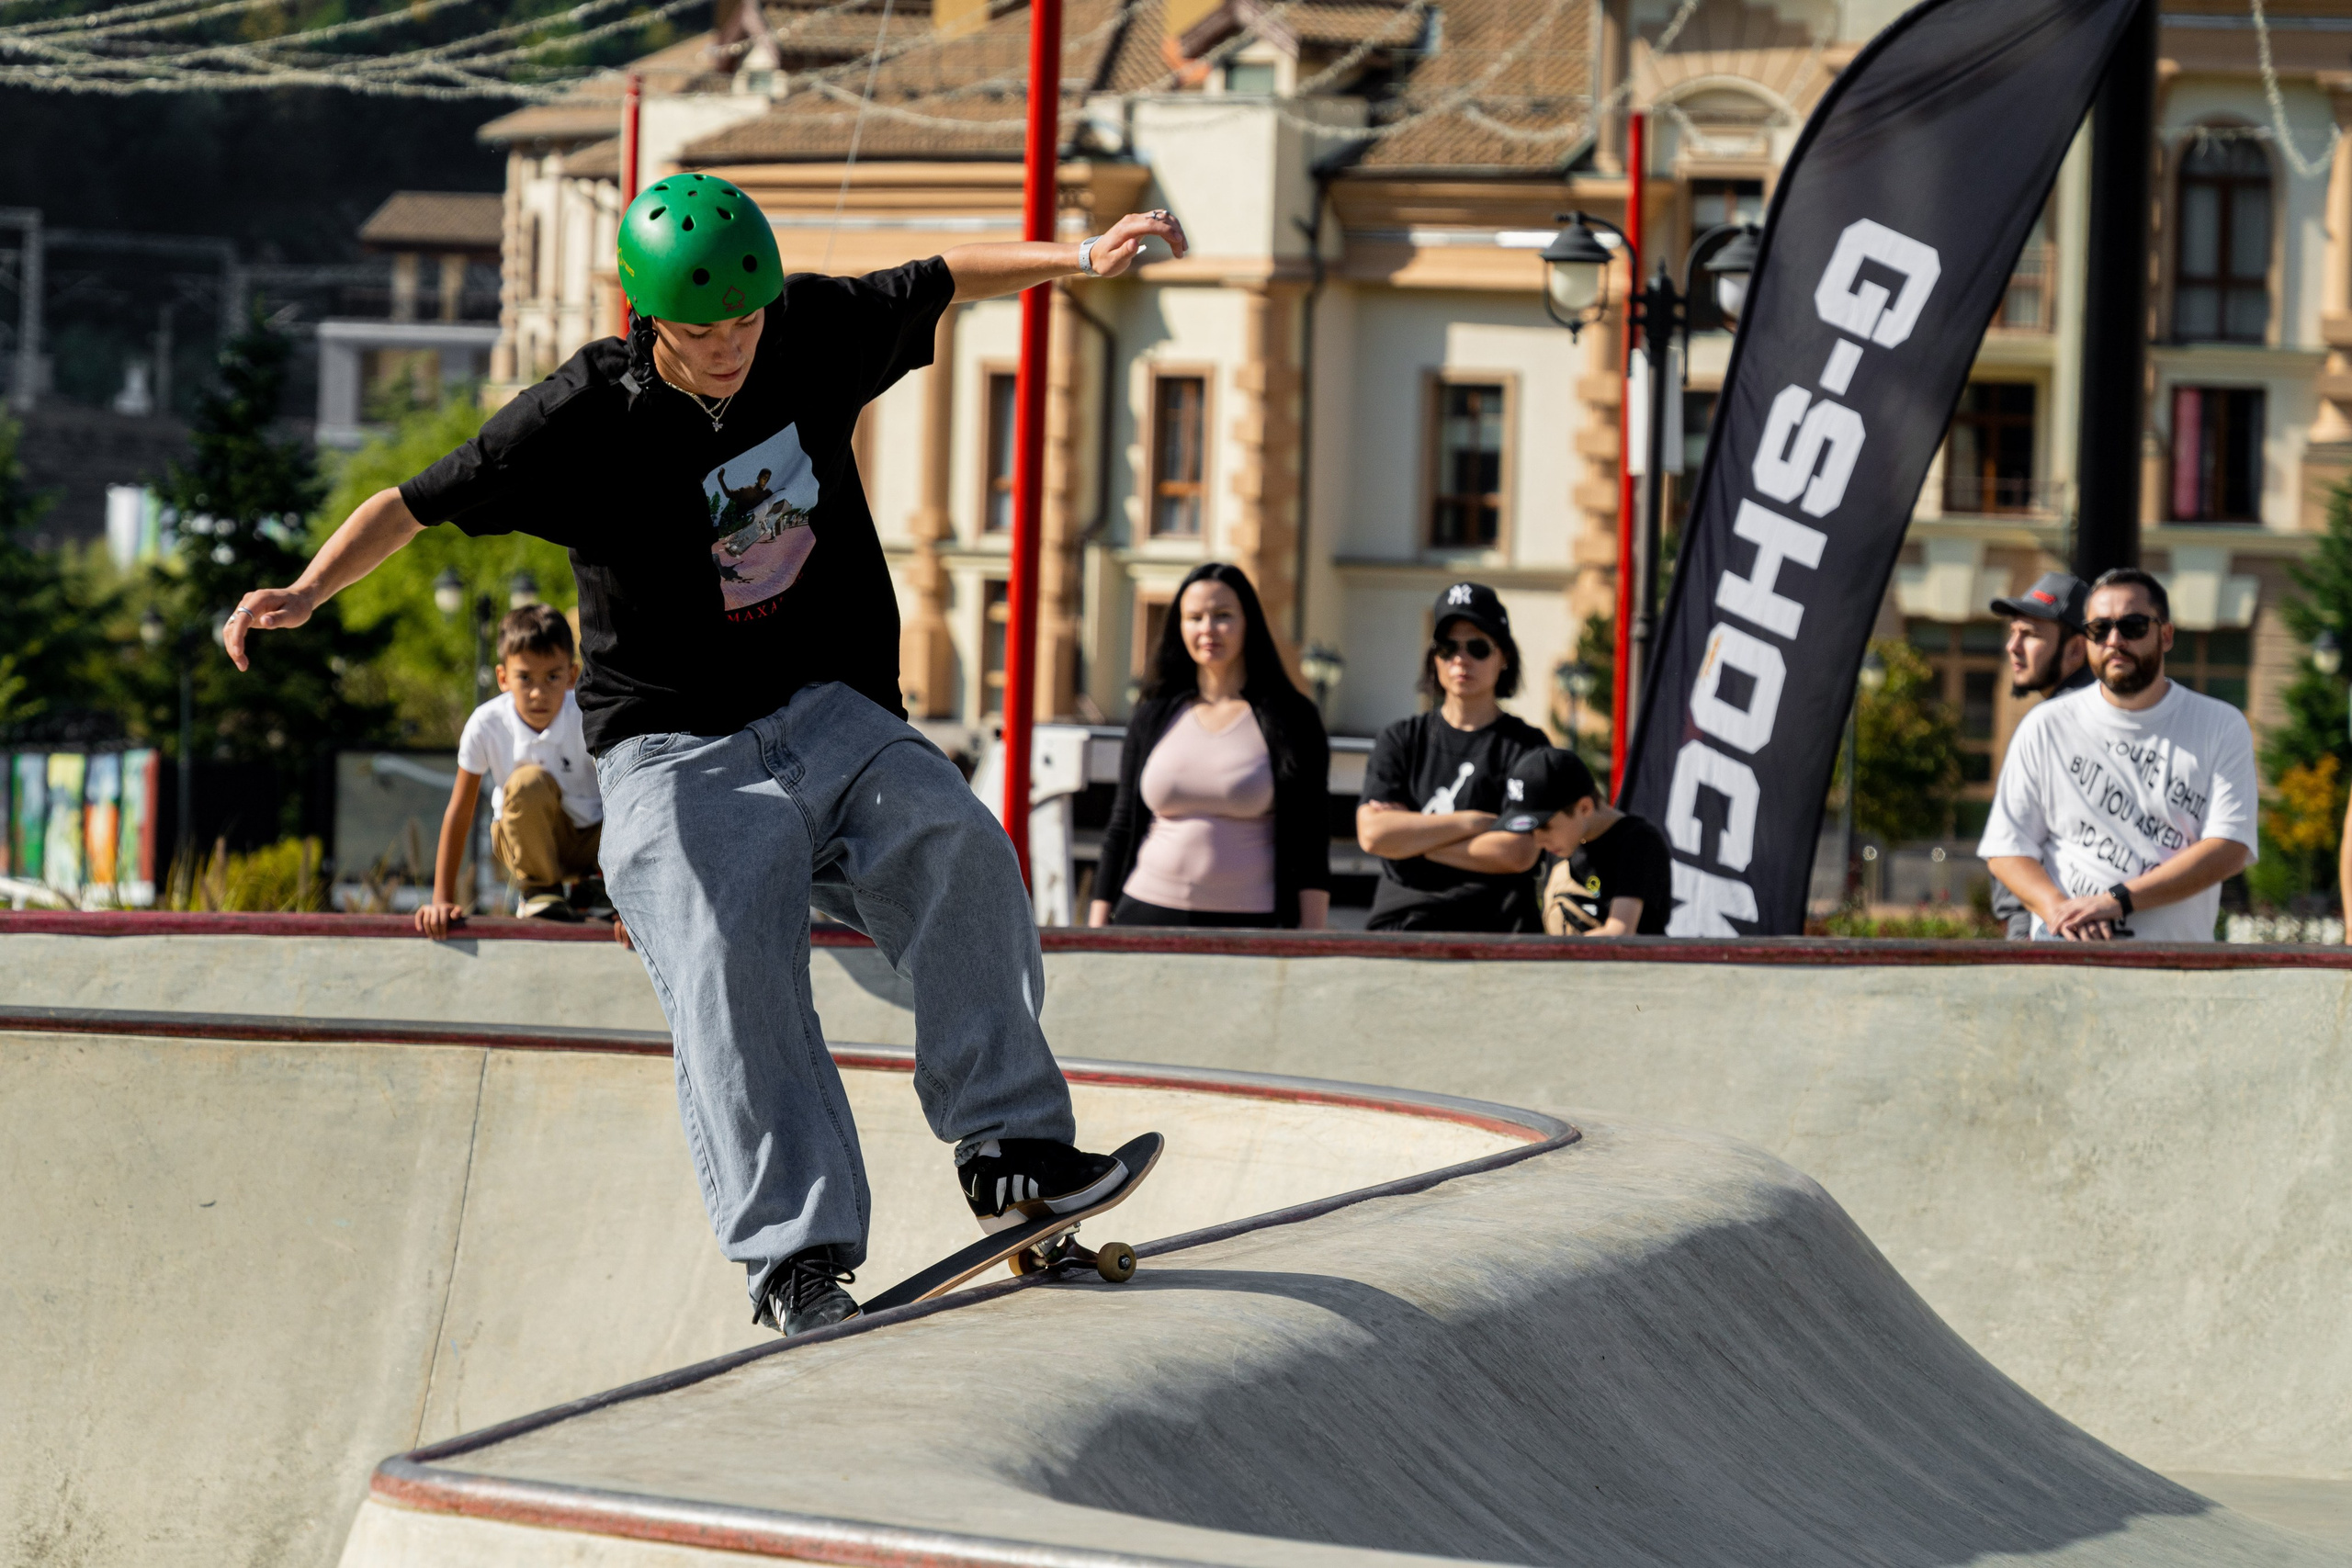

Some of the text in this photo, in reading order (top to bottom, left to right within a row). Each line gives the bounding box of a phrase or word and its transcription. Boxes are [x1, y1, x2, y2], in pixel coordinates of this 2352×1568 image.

[1664, 218, 1942, 937] G-SHOCK
[2070, 756, 2184, 851] BUT YOU ASKED
[2079, 819, 2097, 848] TO
[2097, 837, 2133, 874] CALL
